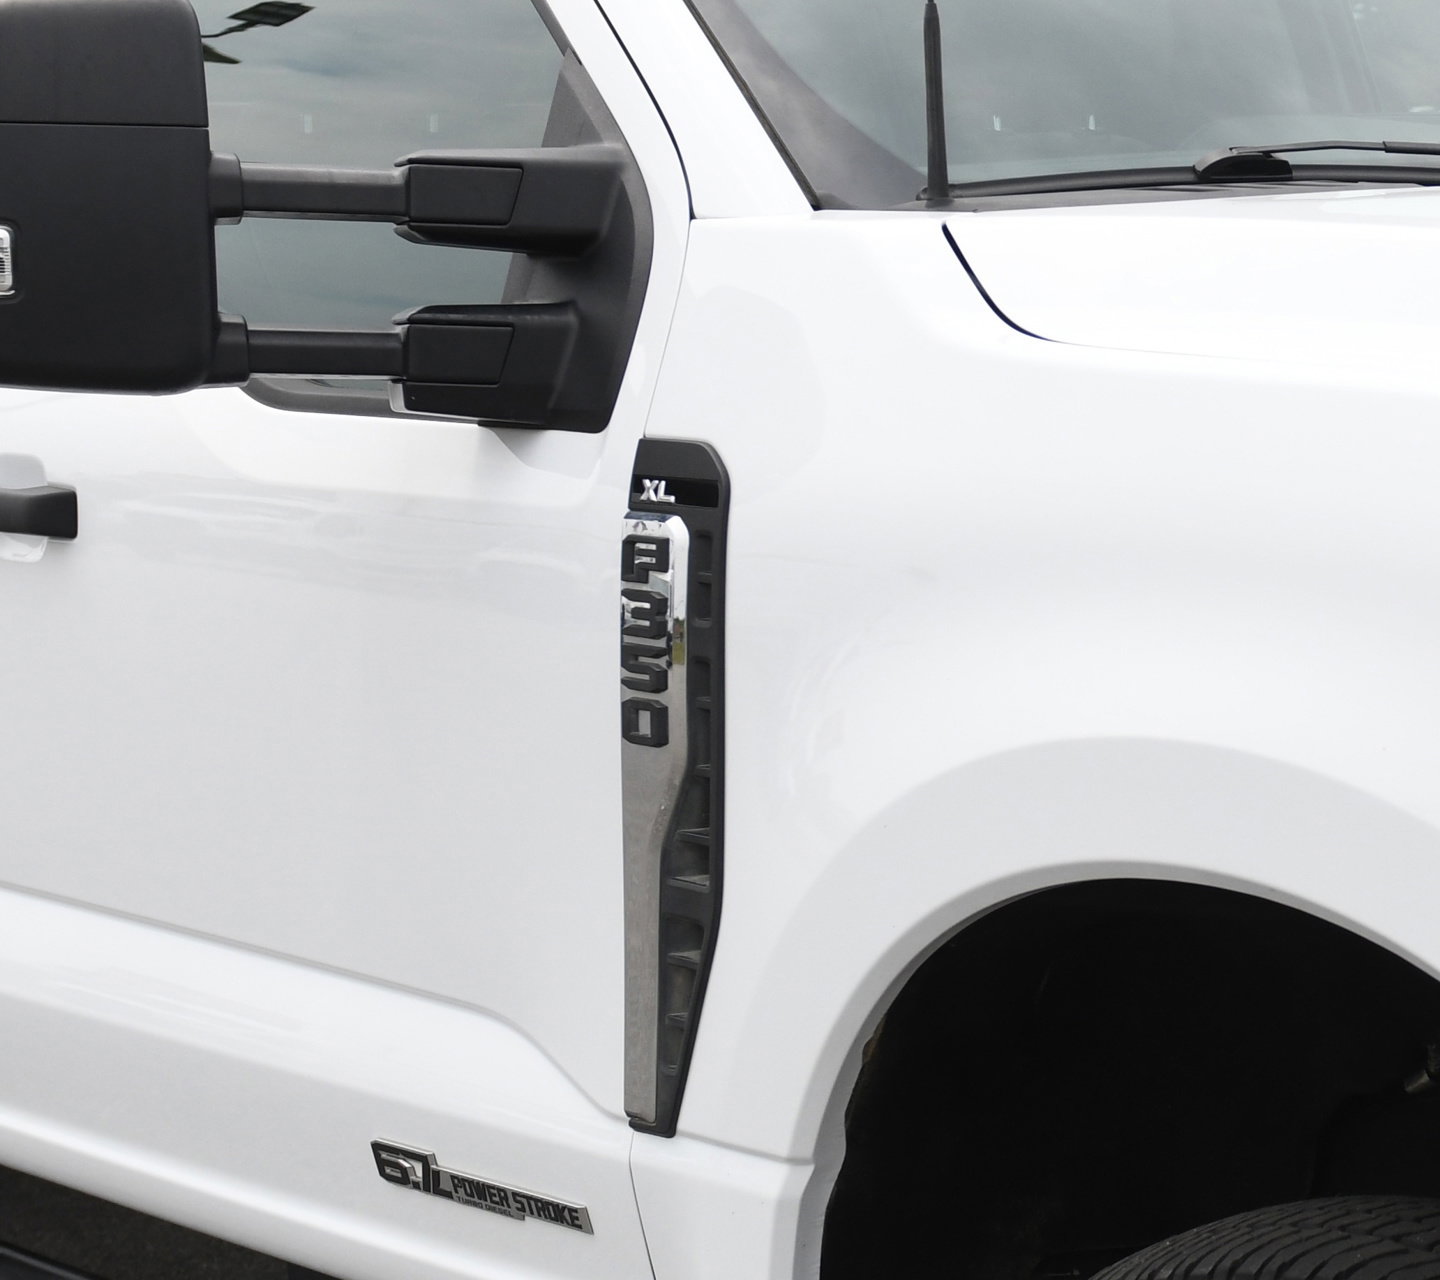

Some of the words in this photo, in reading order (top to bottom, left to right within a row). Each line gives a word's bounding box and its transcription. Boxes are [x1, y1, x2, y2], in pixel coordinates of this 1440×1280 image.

[640, 479, 675, 503] XL
[621, 535, 670, 748] F350
[449, 1174, 512, 1209] POWER
[511, 1191, 583, 1229] STROKE
